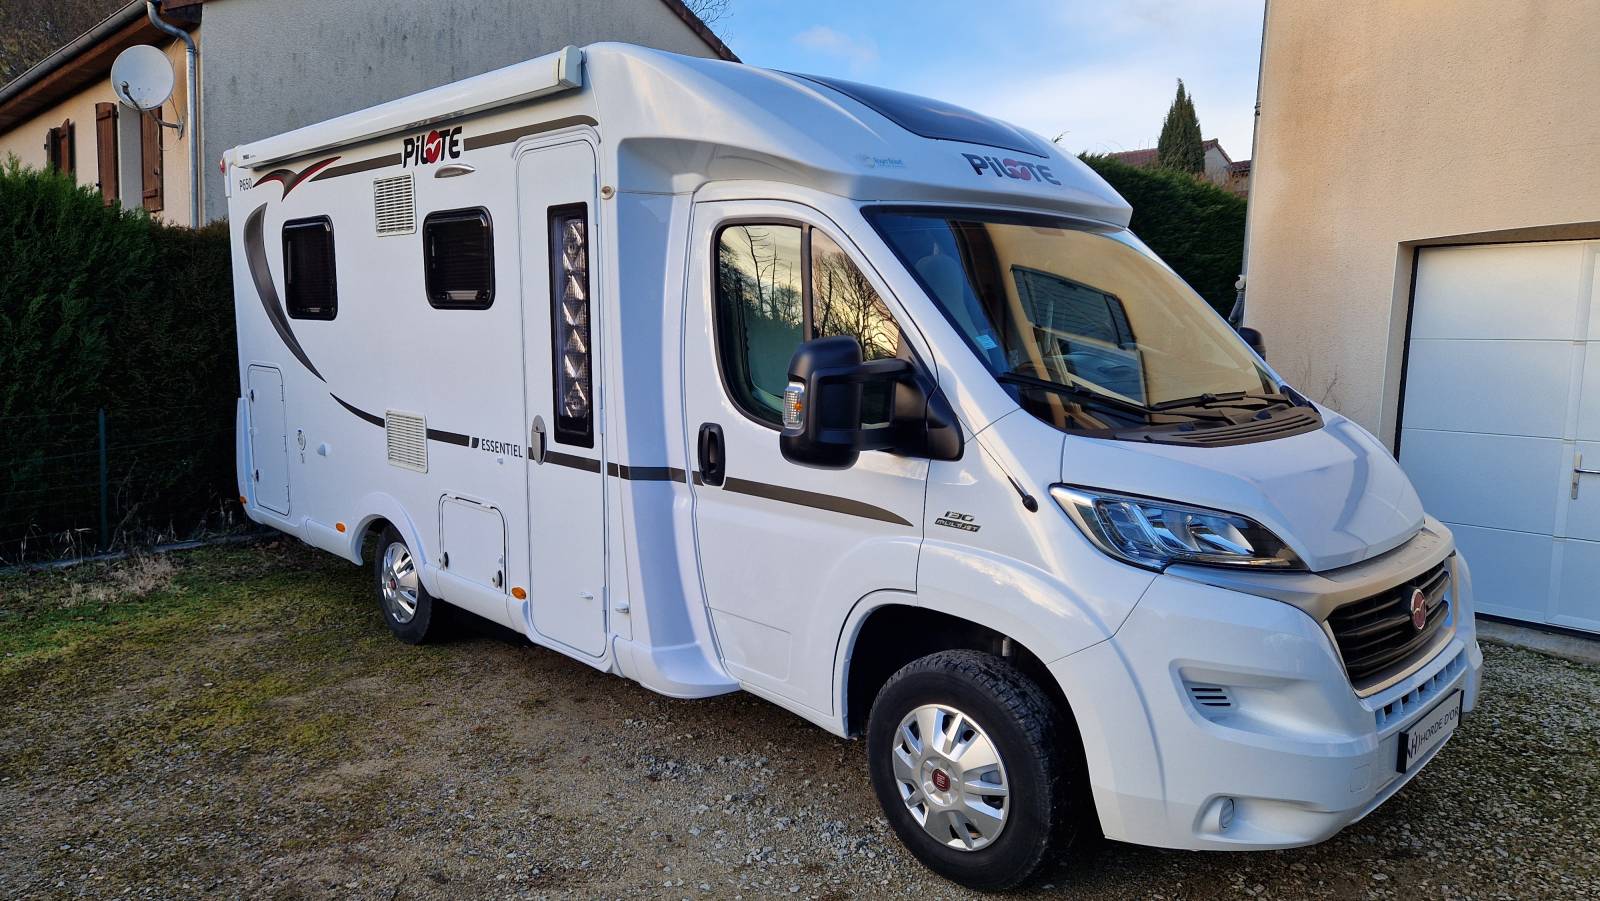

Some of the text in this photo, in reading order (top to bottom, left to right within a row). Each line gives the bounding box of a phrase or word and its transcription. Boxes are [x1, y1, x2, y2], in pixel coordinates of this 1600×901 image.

[240, 177, 253, 192] P650
[482, 439, 523, 458] ESSENTIEL
[1421, 718, 1443, 745] HORDE
